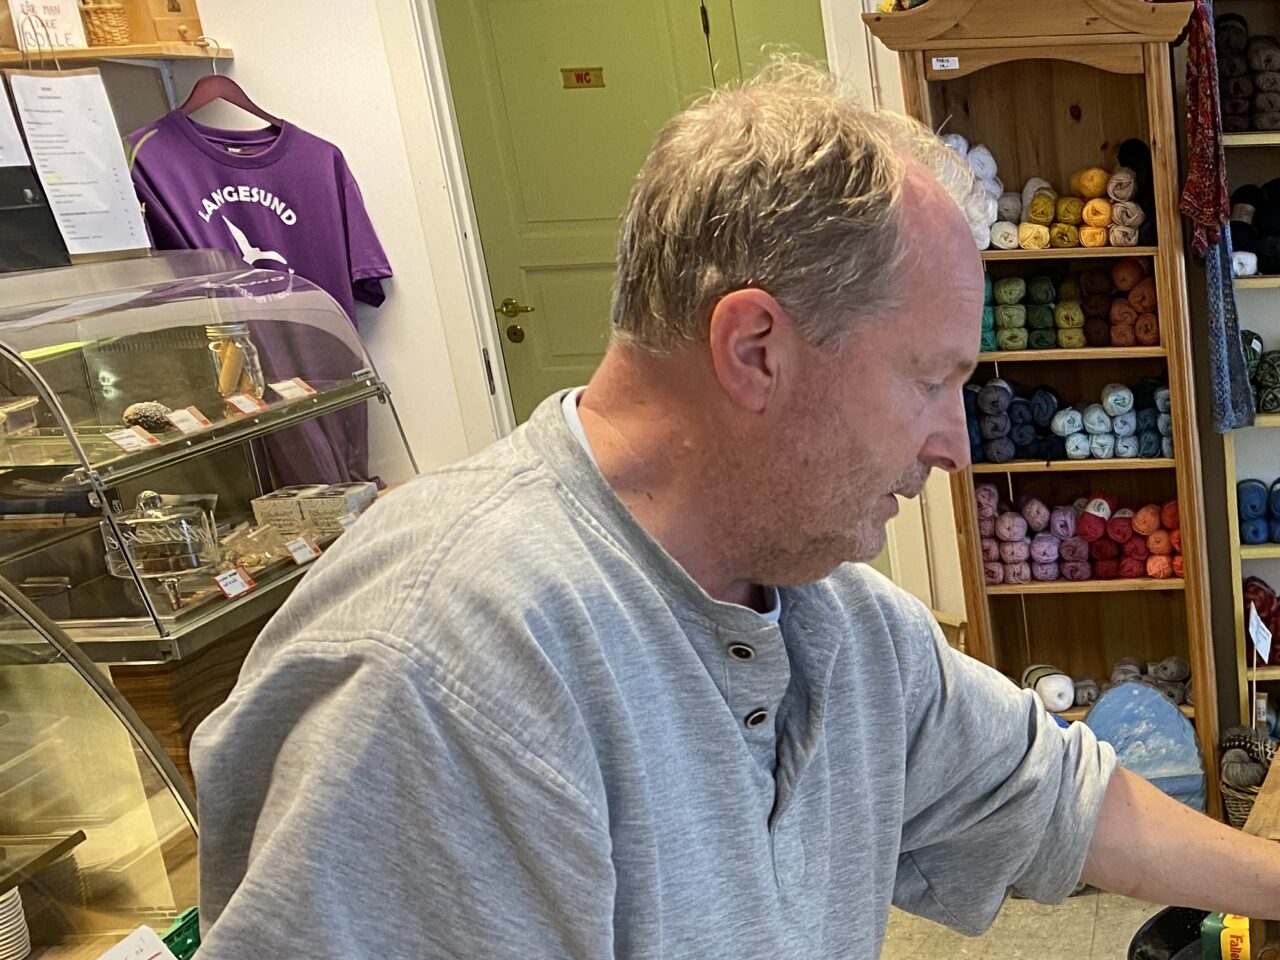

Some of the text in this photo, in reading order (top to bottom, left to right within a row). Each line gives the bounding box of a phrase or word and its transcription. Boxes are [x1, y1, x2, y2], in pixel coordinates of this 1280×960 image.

[24, 32, 75, 48] BOLLE
[575, 72, 591, 84] WC
[198, 186, 297, 225] LANGESUND
